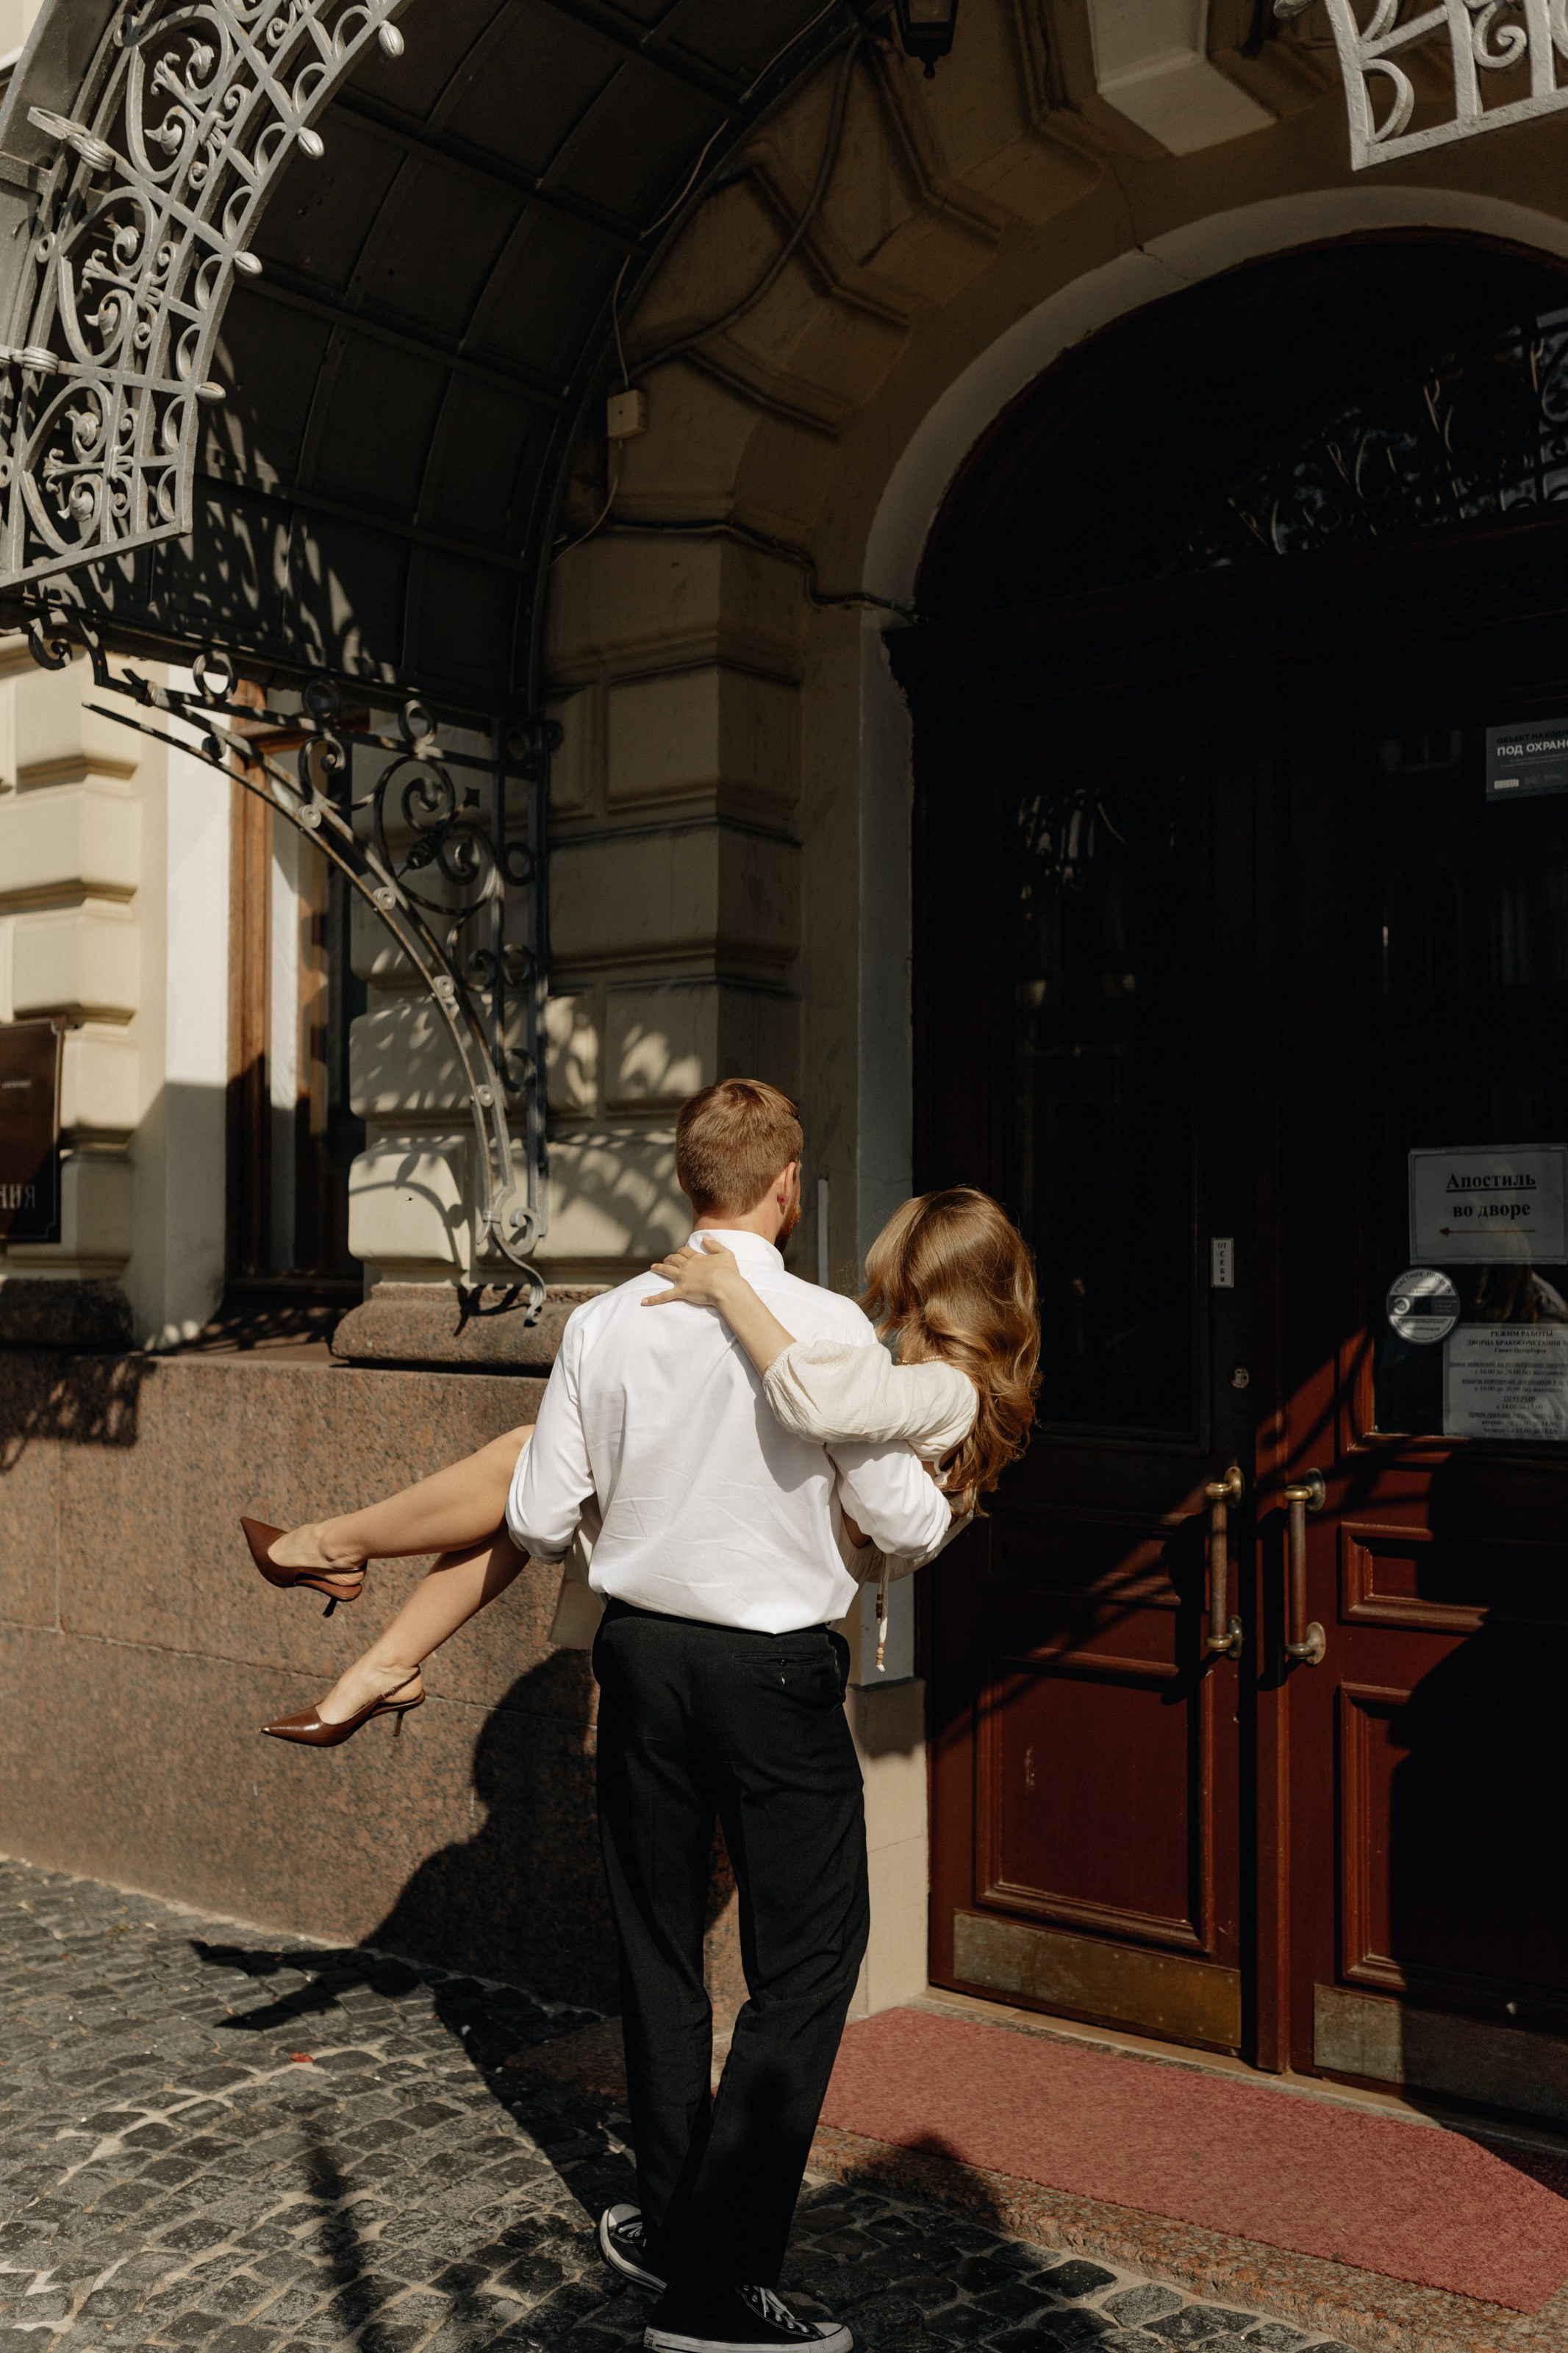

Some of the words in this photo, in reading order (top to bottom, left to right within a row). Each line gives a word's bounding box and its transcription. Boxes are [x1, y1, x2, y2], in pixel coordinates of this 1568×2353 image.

[1497, 734, 1529, 744] ОБЪЕКТ
[1497, 744, 1523, 756] ПОД
[1526, 739, 1568, 753] ОХРАН
[1446, 1173, 1536, 1191] Апостиль
[1453, 1206, 1472, 1218] во
[1478, 1204, 1531, 1221] дворе
[1393, 1271, 1424, 1293] УЧАСТНИК
